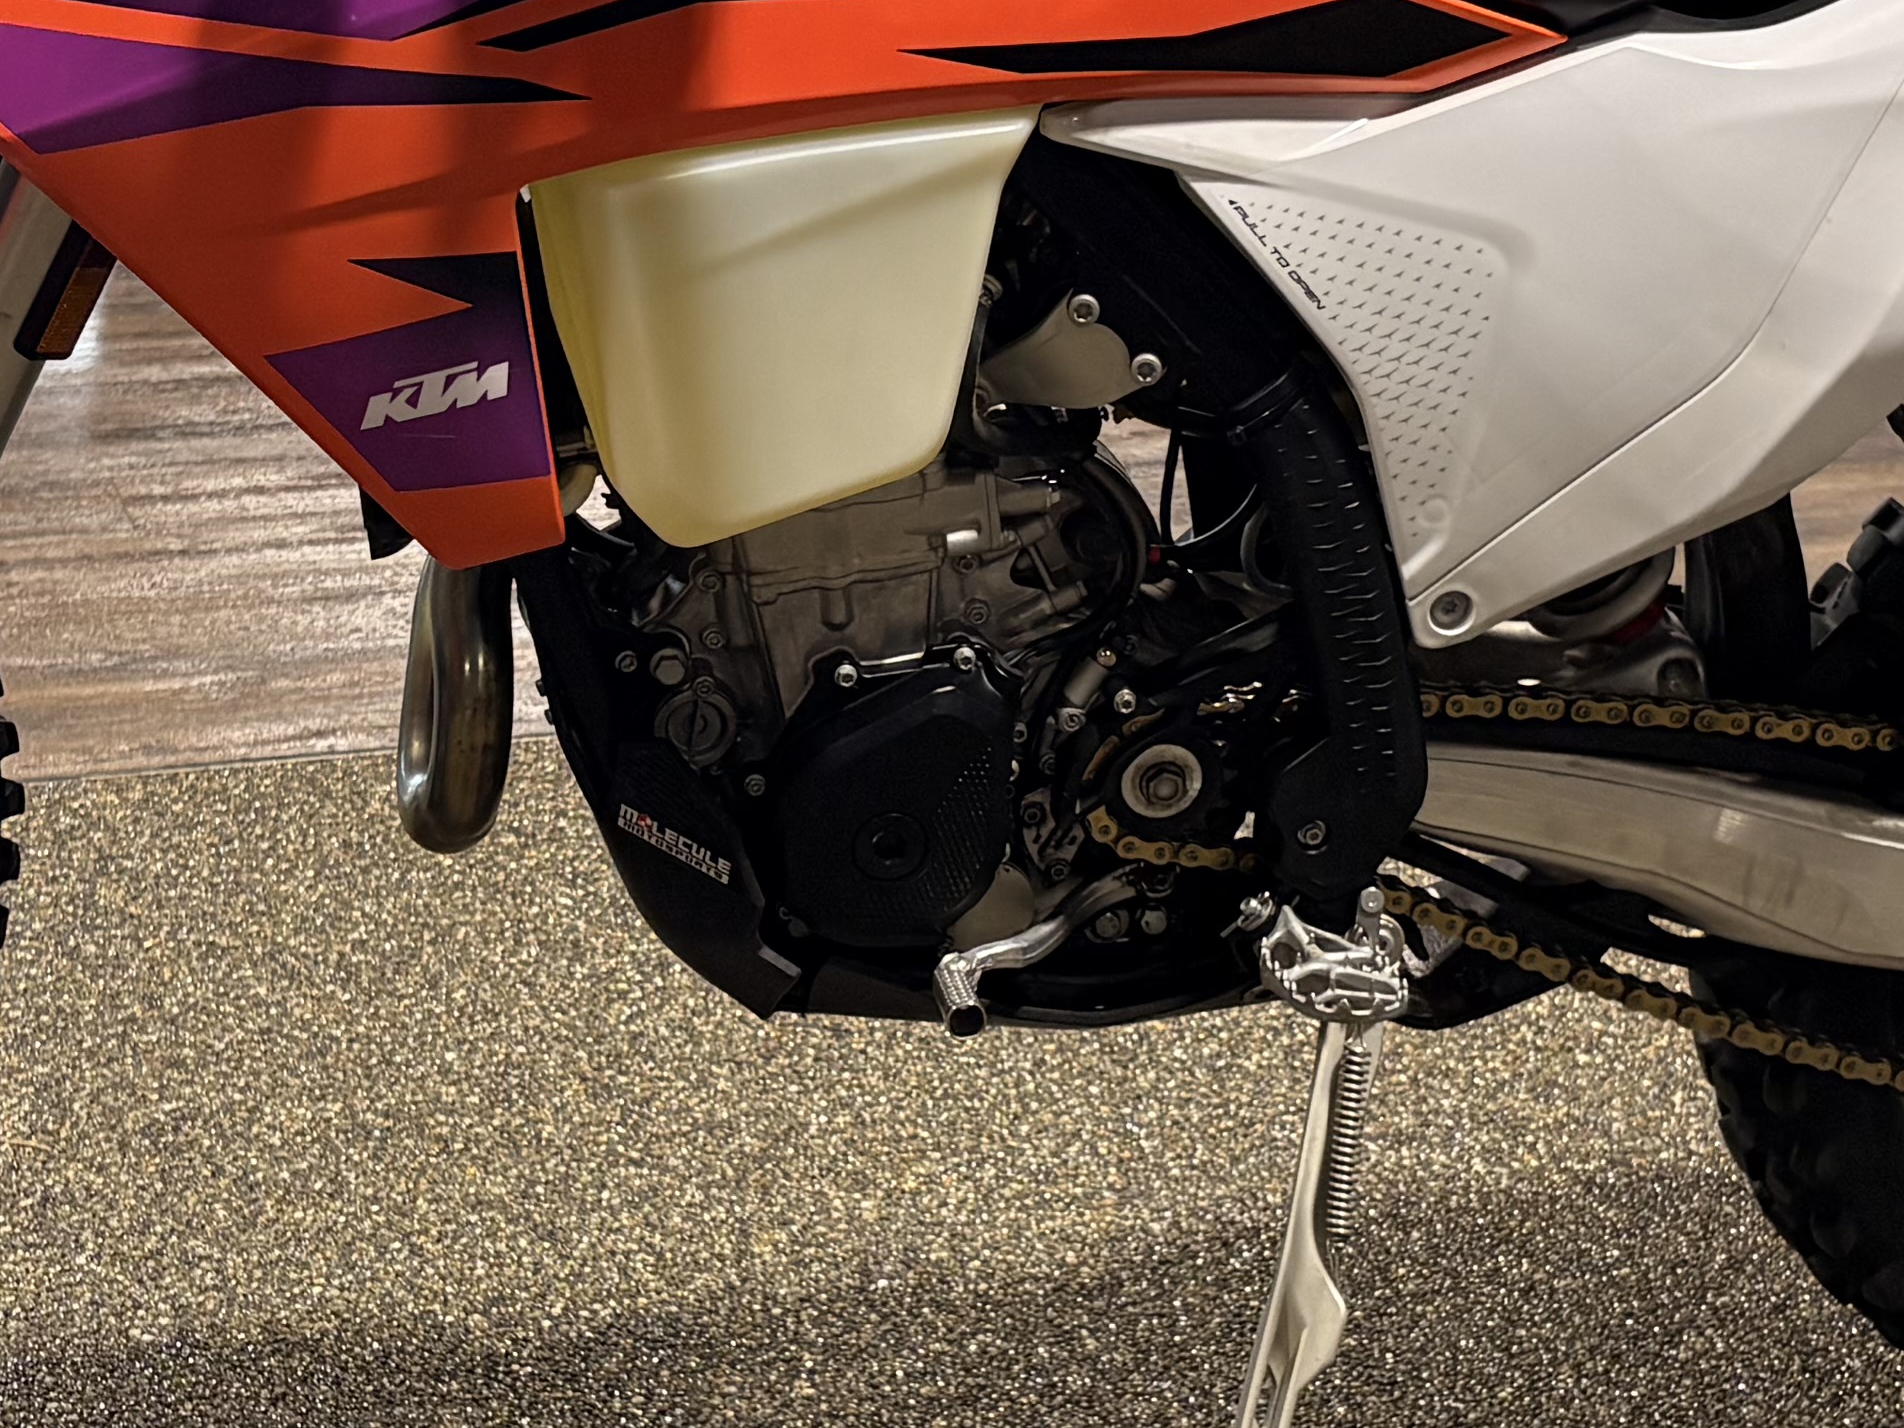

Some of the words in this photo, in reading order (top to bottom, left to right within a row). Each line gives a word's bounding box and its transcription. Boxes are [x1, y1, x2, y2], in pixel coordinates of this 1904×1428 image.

[1233, 205, 1267, 247] PULL
[1270, 246, 1290, 268] TO
[1287, 270, 1326, 310] OPEN
[360, 360, 509, 431] KTM
